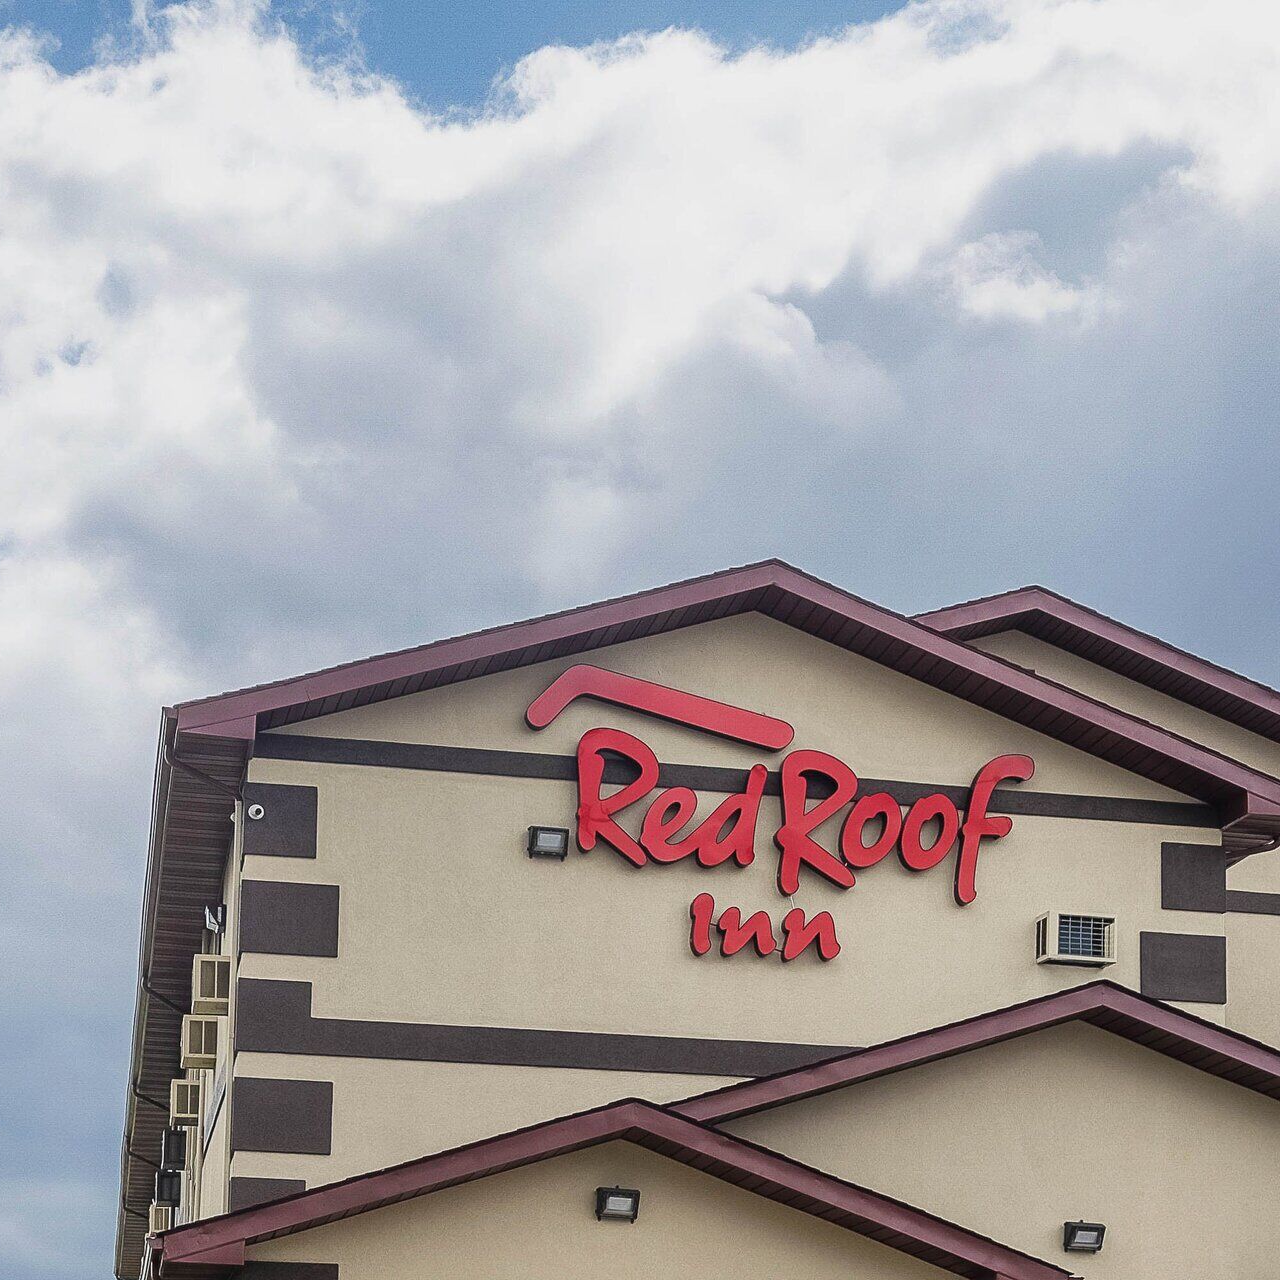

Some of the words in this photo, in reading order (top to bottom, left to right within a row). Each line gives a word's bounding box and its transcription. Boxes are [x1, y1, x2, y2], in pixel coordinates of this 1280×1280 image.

[576, 727, 768, 868] Red
[776, 749, 1035, 905] Roof
[689, 892, 841, 962] Inn
